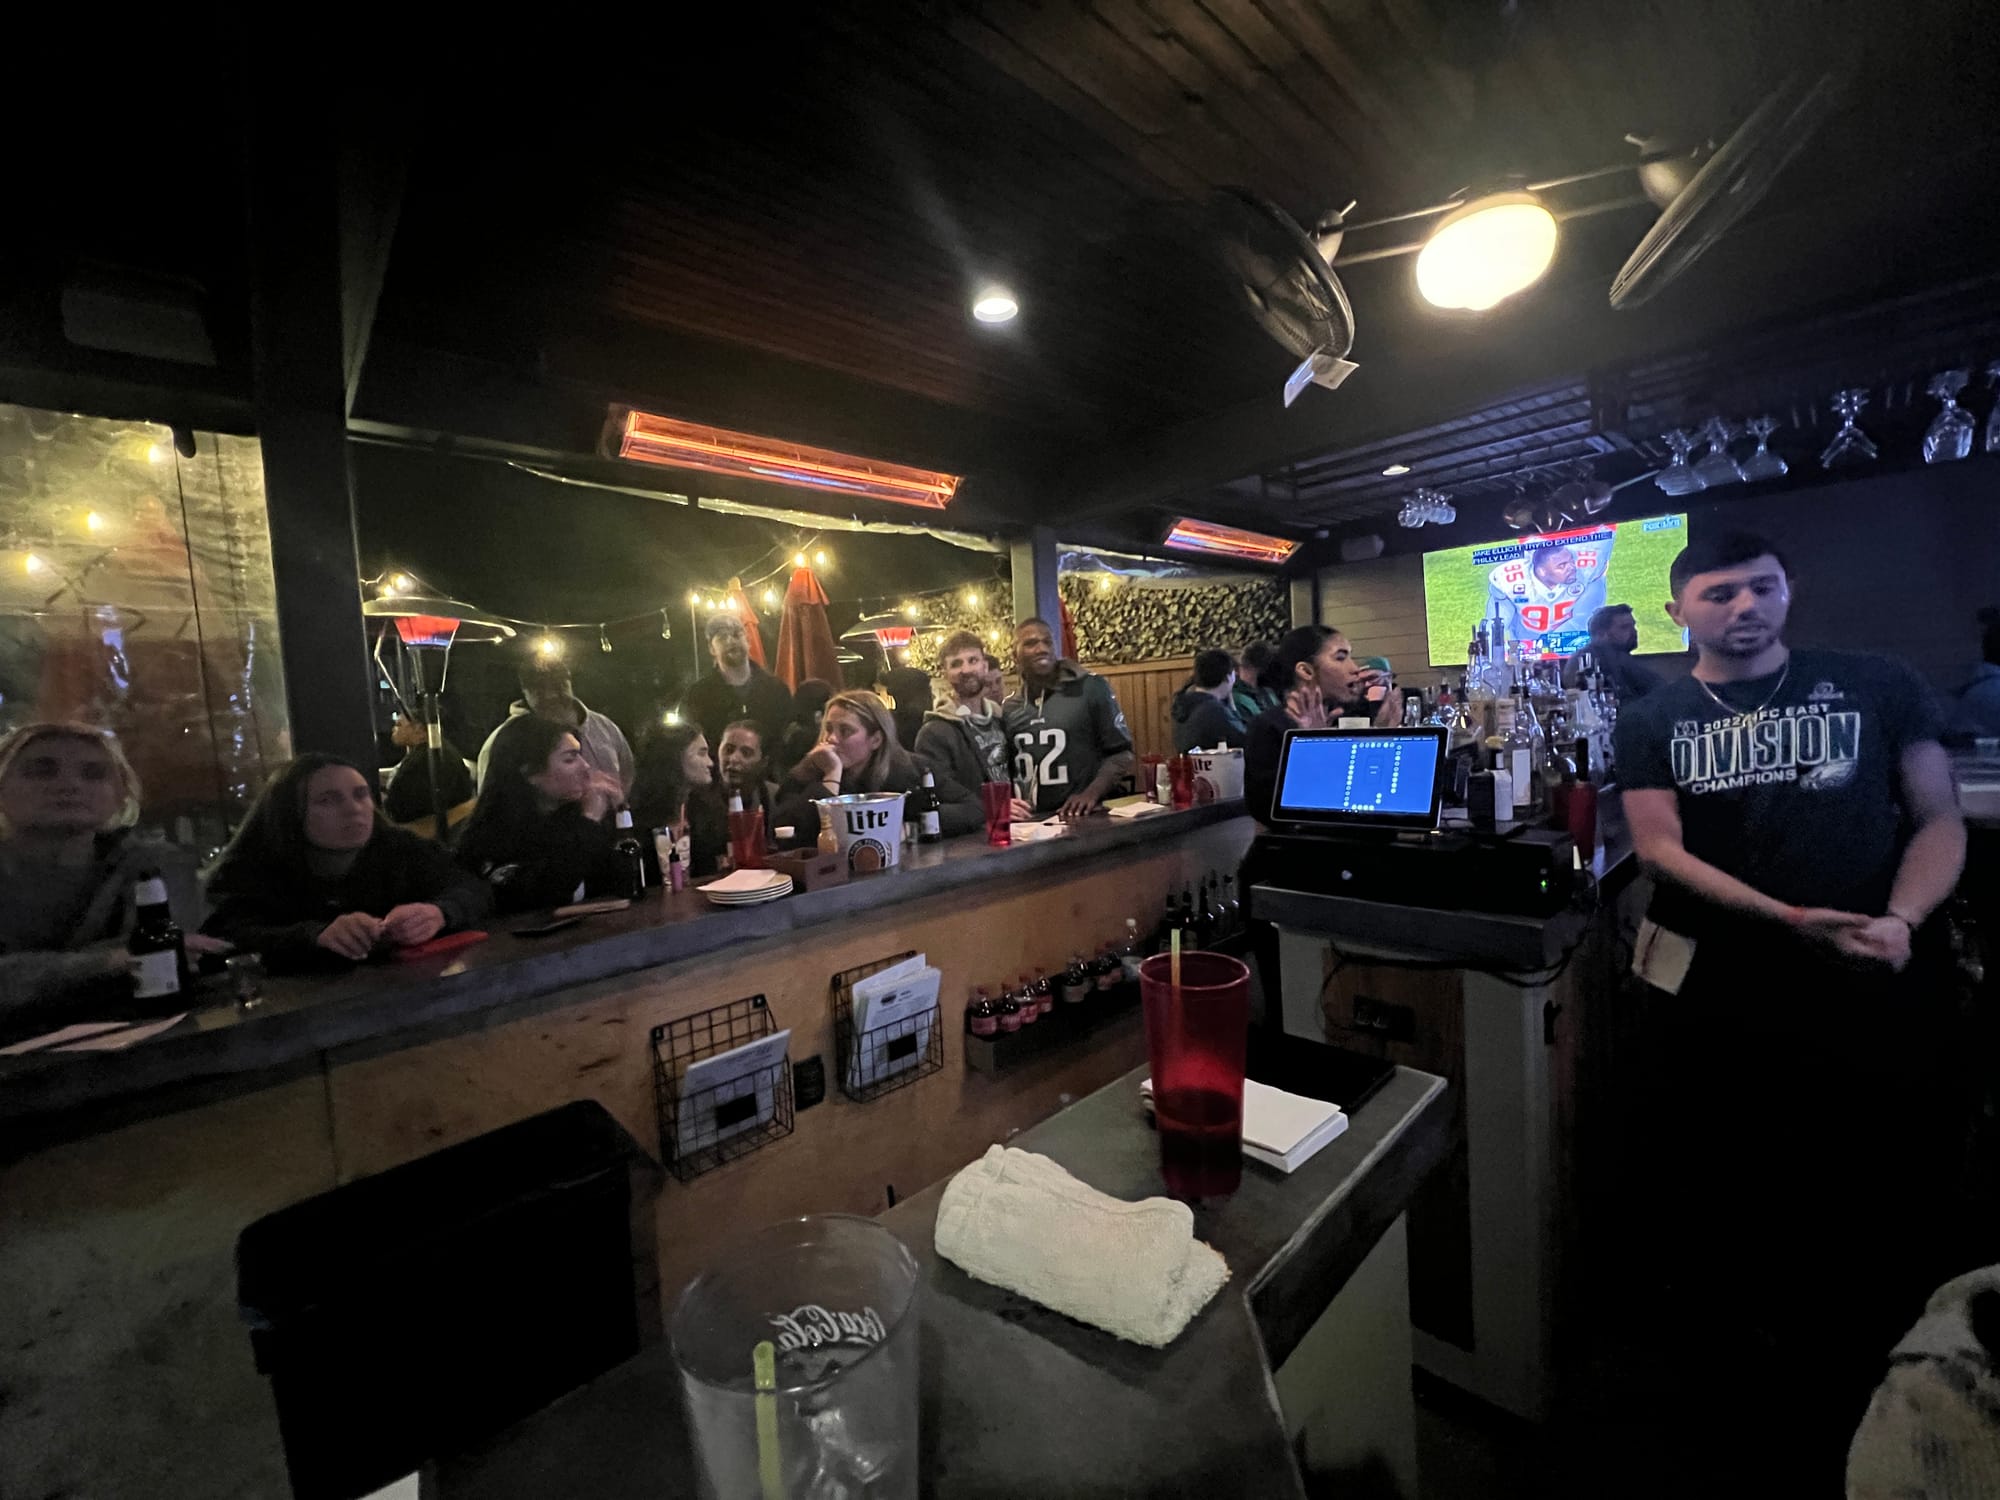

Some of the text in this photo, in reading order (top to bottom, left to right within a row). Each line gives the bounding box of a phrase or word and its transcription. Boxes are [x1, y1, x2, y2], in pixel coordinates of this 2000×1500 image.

[1473, 549, 1491, 557] JAKE
[1492, 545, 1522, 555] ELLIOTT
[1543, 540, 1554, 548] TO
[1555, 535, 1589, 546] EXTEND
[1473, 555, 1498, 565] PHILLY
[1532, 638, 1561, 649] 14 21
[1703, 716, 1741, 734] 2022
[1785, 703, 1830, 717] EAST
[1014, 728, 1069, 786] 62
[1671, 712, 1860, 785] DIVISION
[1691, 768, 1798, 795] CHAMPIONS
[846, 810, 889, 836] Lite
